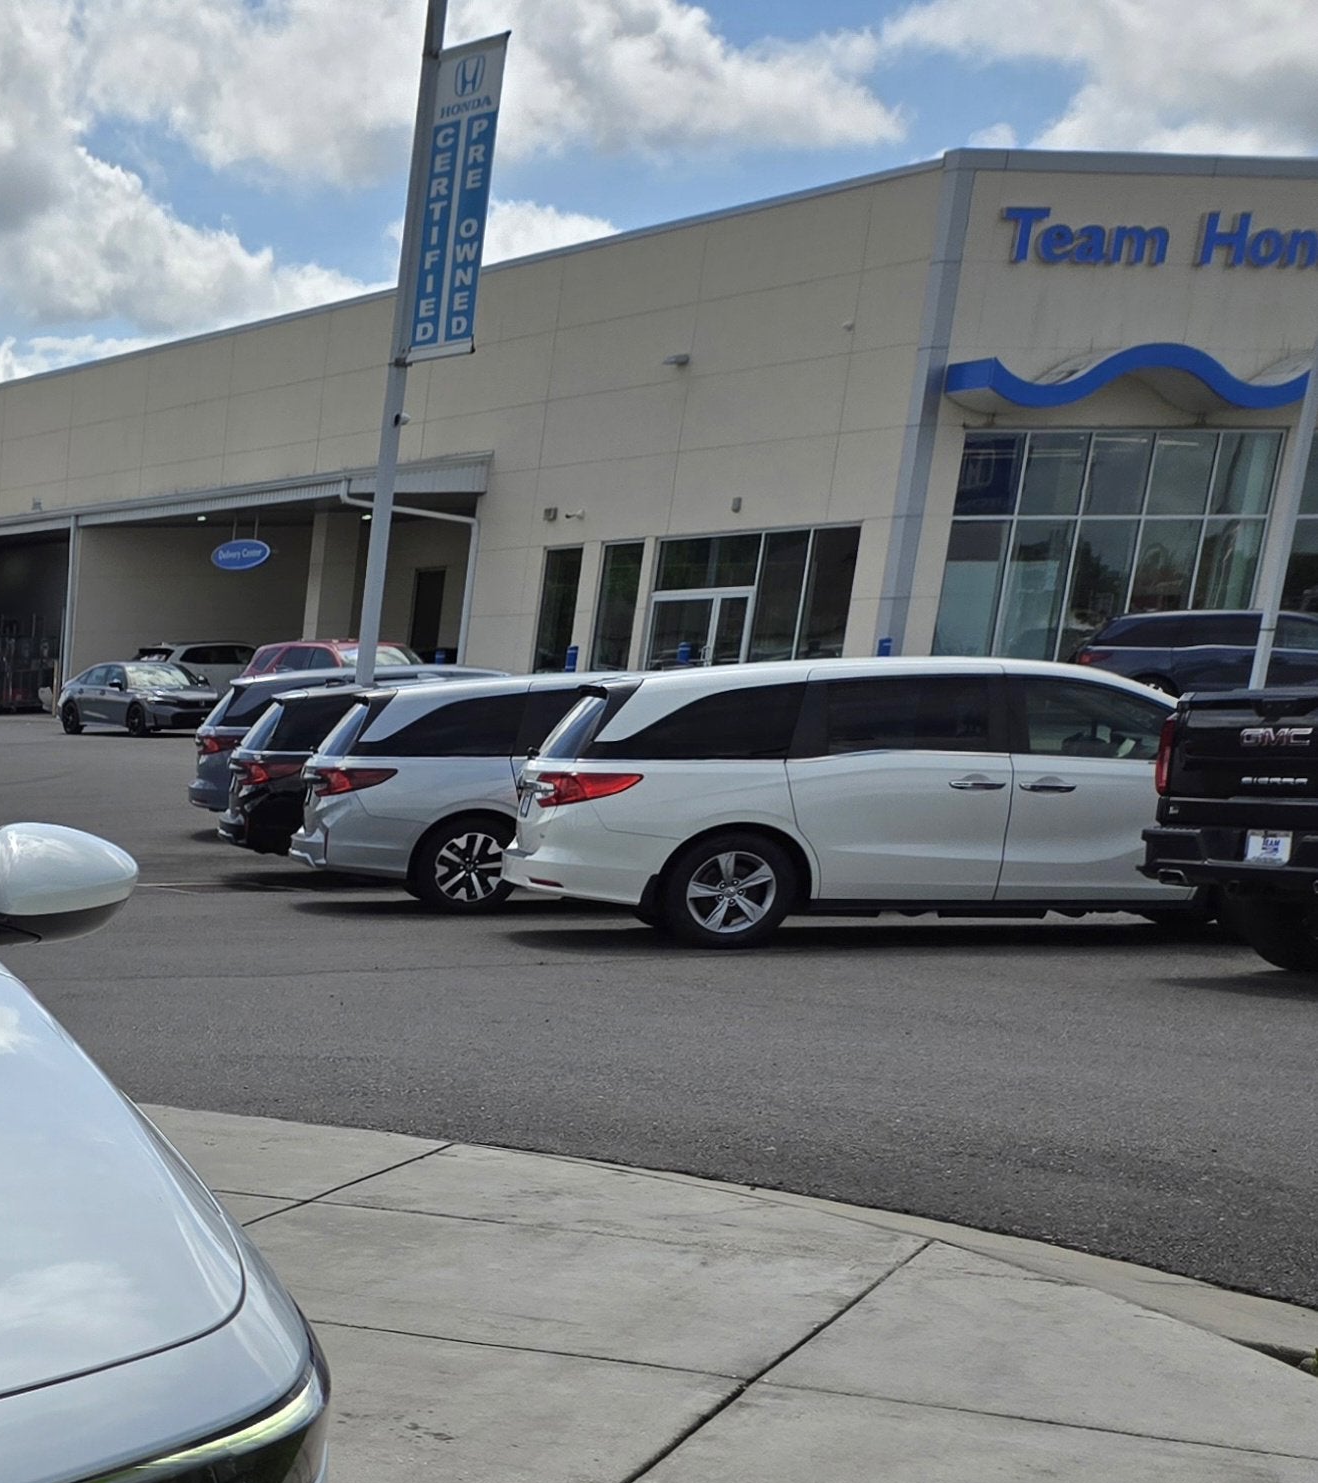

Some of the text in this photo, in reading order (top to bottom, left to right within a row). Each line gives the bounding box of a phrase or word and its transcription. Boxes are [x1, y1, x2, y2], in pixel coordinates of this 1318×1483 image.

[439, 95, 492, 119] HONDA
[416, 128, 454, 341] CERTIFIED
[451, 118, 487, 335] PRE OWNED
[1002, 206, 1170, 266] Team
[1240, 728, 1313, 746] GMC
